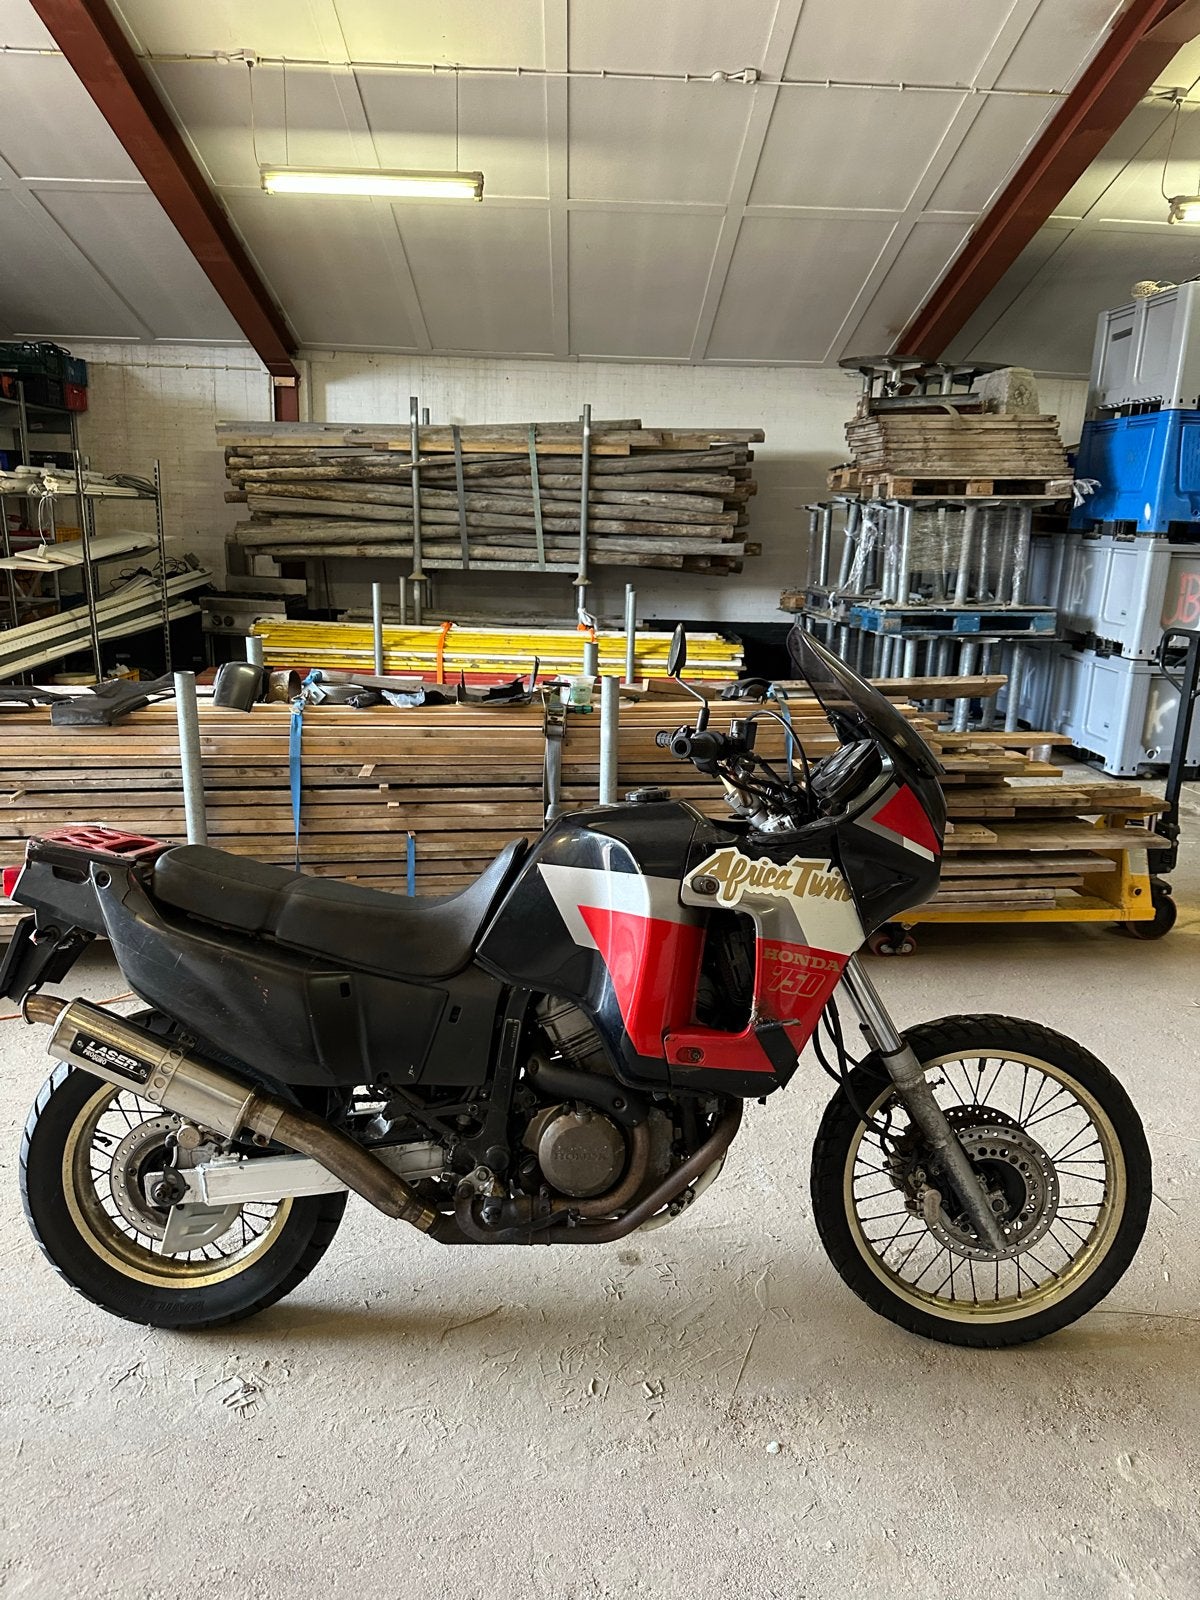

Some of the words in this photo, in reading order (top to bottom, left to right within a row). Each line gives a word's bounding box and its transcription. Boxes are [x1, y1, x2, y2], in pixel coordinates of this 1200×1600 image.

[1146, 690, 1177, 740] K
[698, 850, 794, 902] Africa
[791, 860, 854, 903] Twin
[763, 947, 842, 973] HONDA
[767, 965, 826, 998] 750
[86, 1041, 139, 1070] LASER
